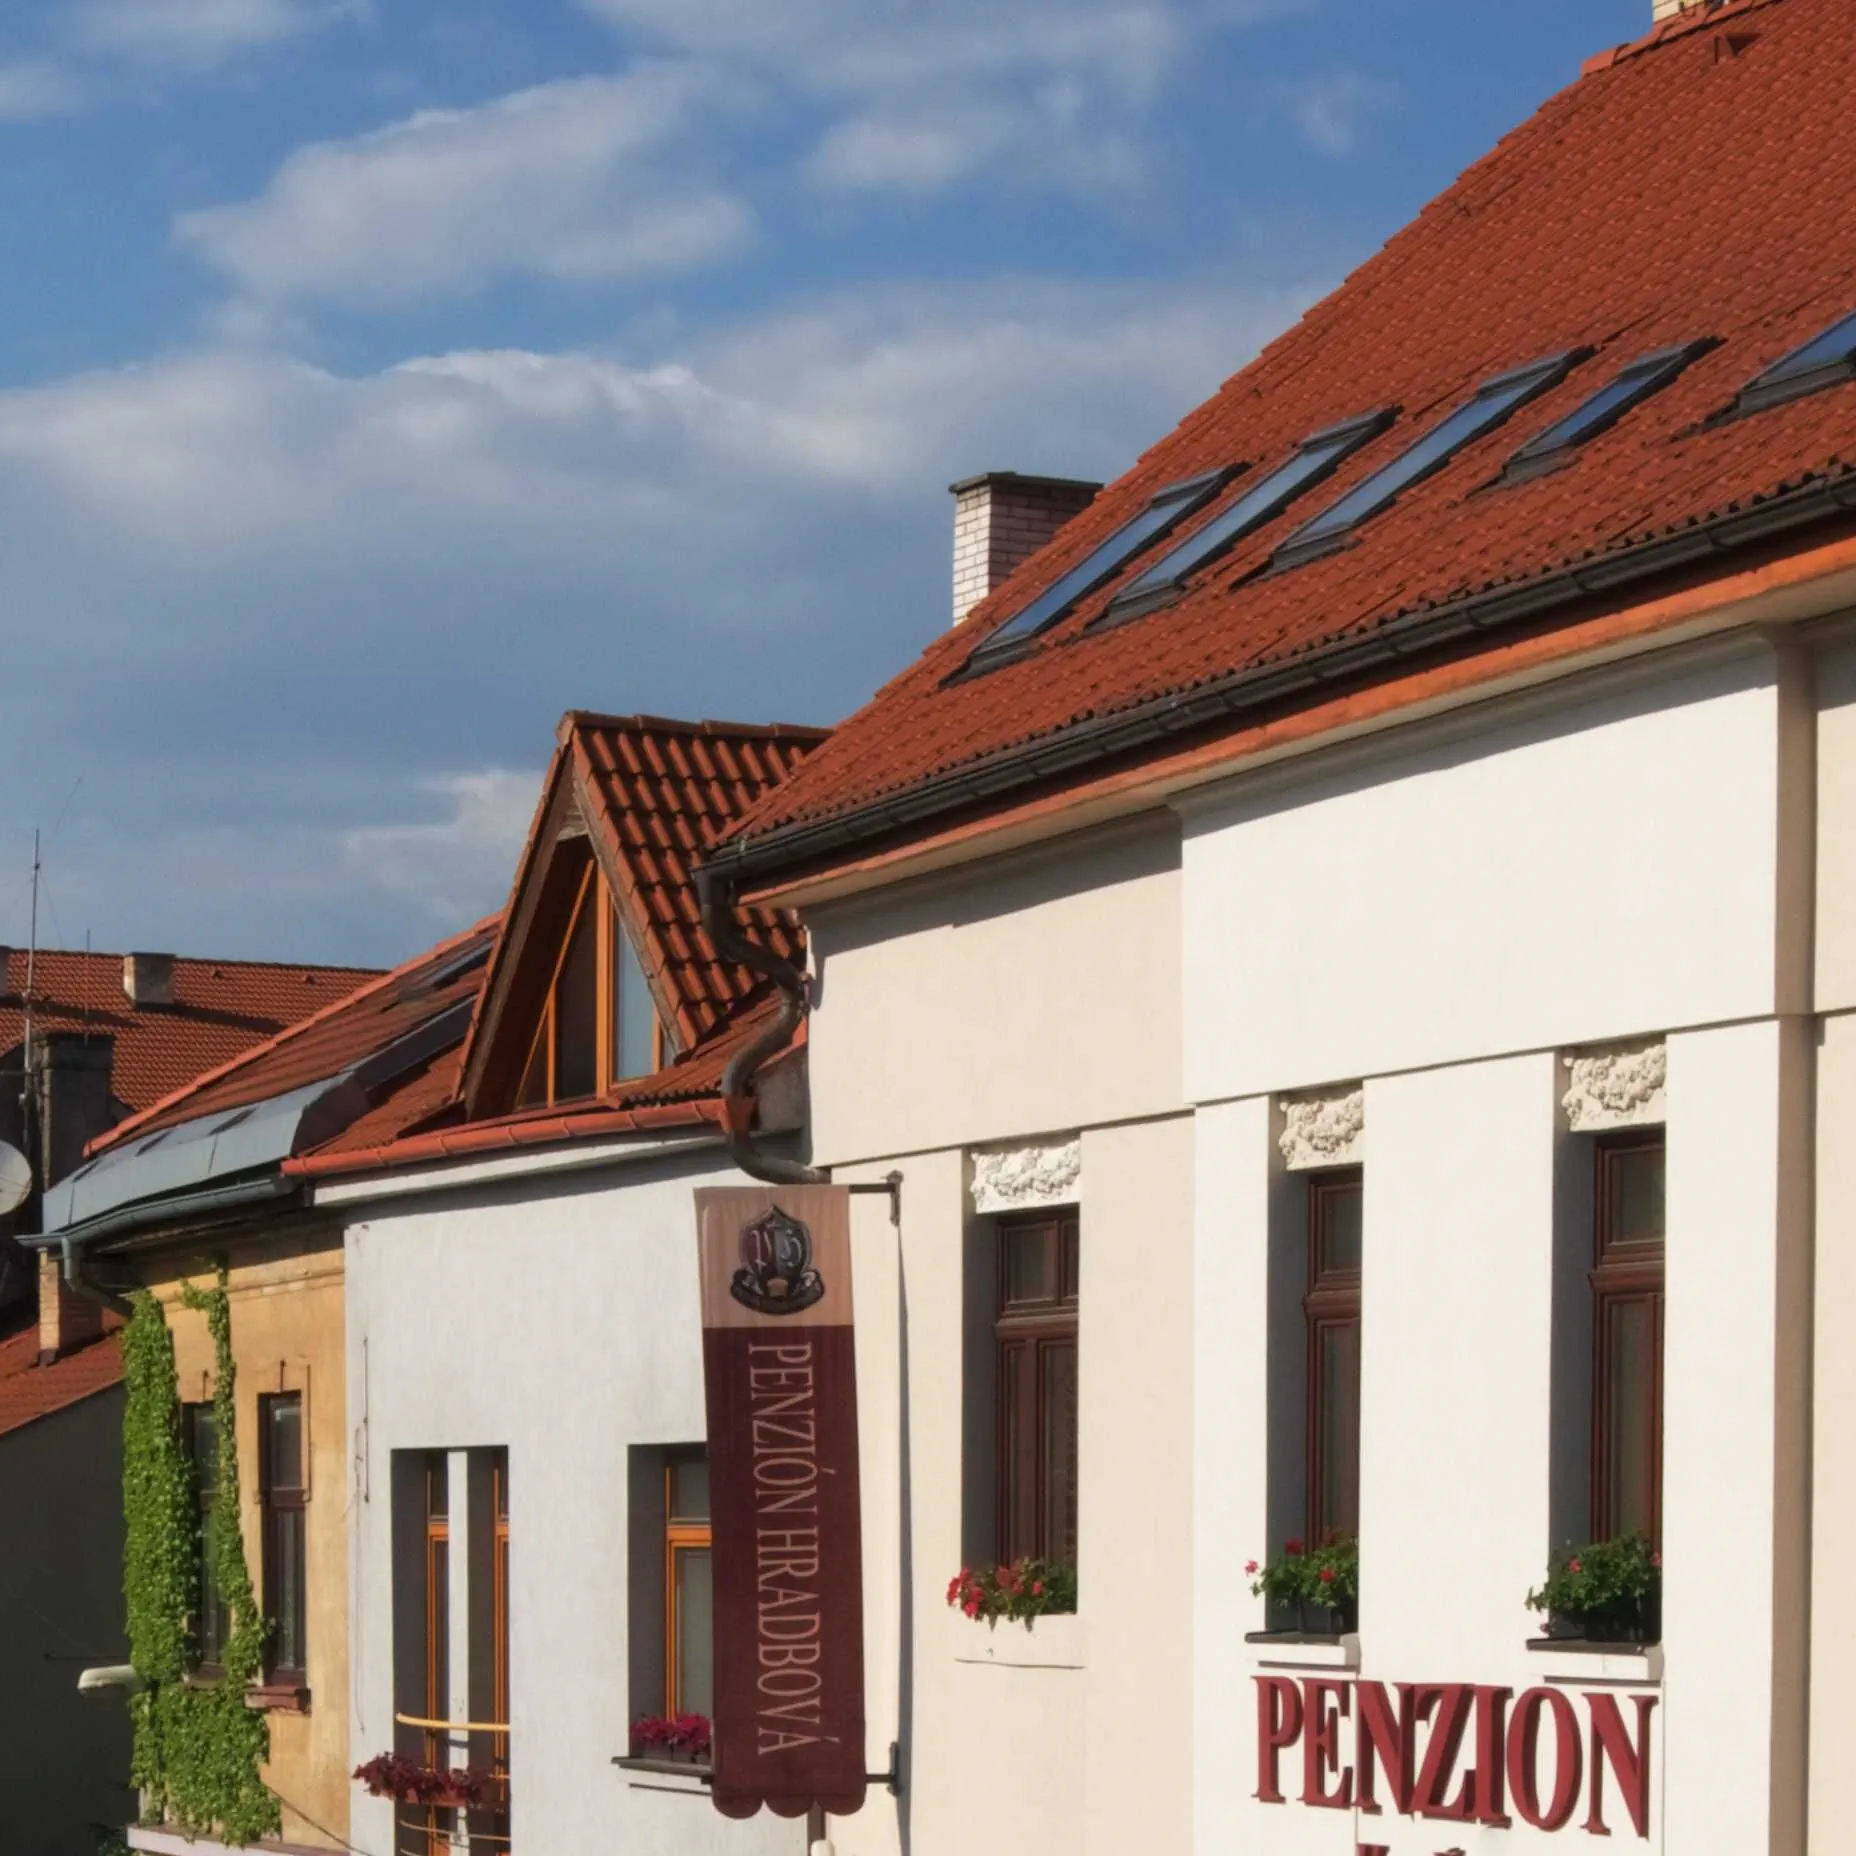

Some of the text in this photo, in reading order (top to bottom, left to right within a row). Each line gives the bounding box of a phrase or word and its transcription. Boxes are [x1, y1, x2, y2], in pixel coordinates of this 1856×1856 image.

[747, 1341, 841, 1757] PENZIÓN HRADBOVÁ
[1250, 1675, 1660, 1842] PENZION
